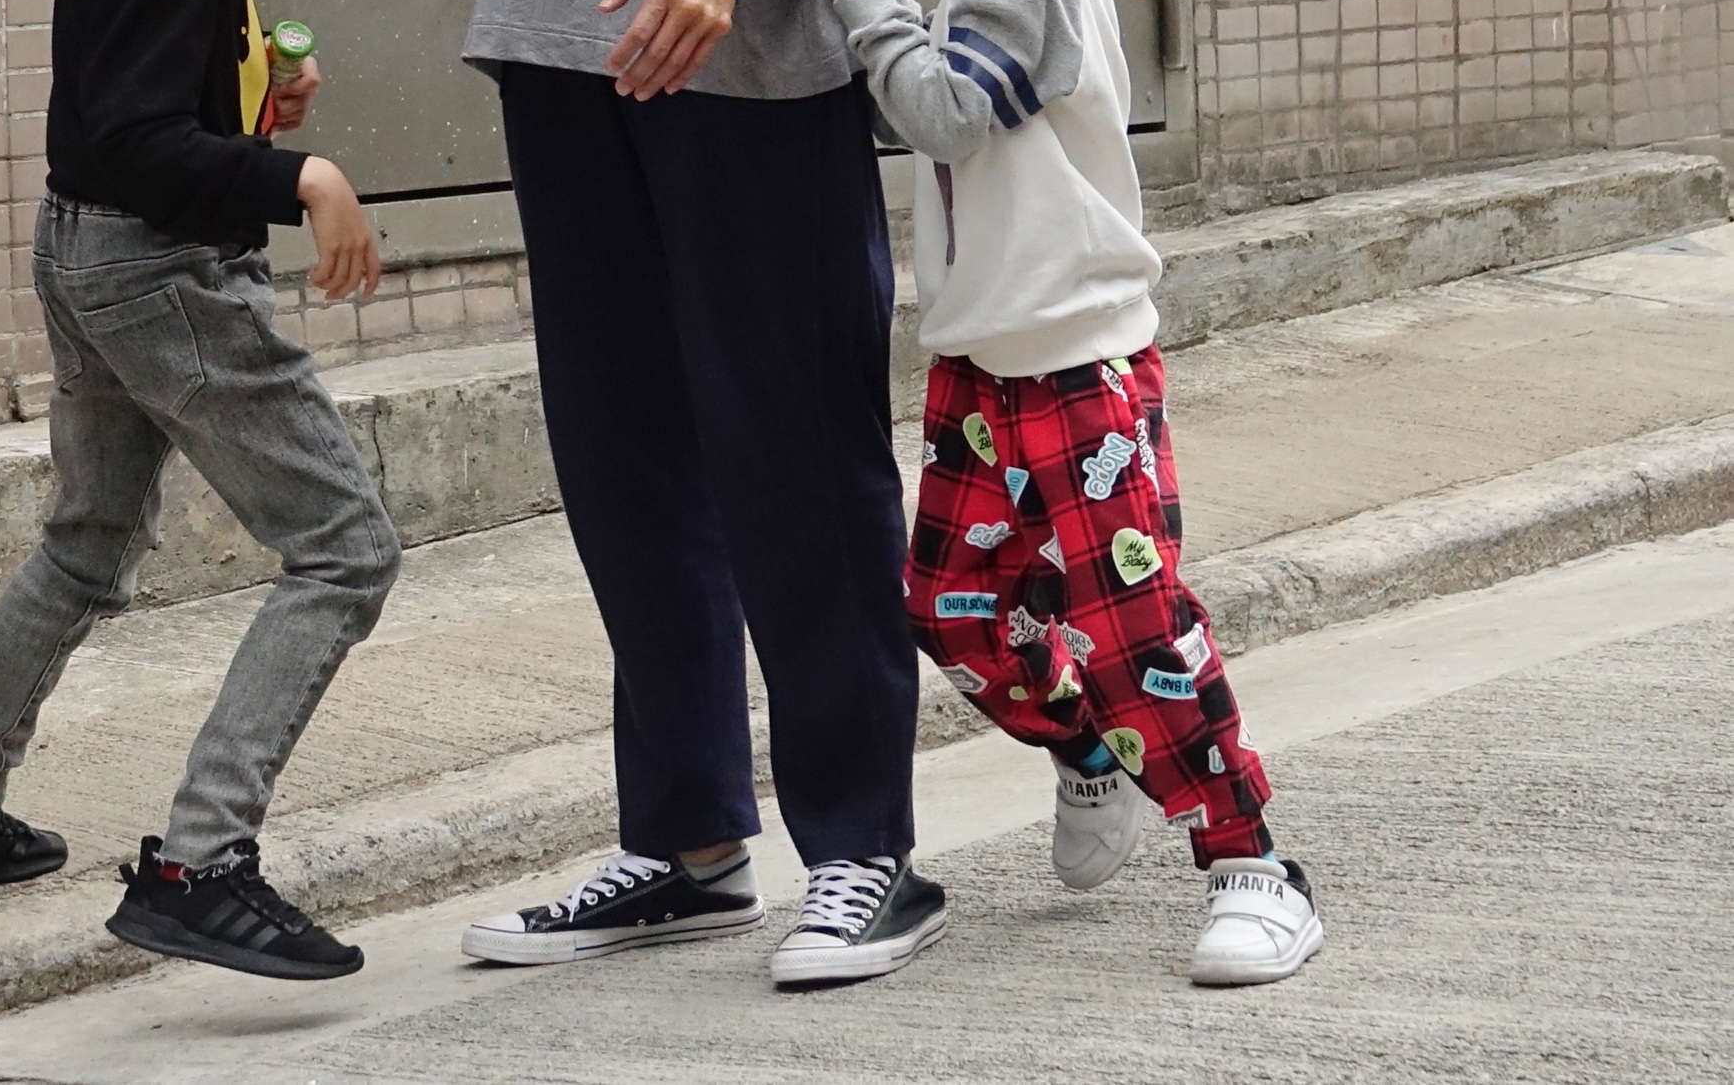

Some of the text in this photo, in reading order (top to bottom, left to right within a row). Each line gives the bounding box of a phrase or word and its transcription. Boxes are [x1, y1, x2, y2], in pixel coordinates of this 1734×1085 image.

[1090, 437, 1129, 494] Nope
[1125, 539, 1146, 557] My
[1121, 554, 1154, 572] Baby
[944, 597, 967, 611] OUR
[1152, 676, 1181, 693] BABY
